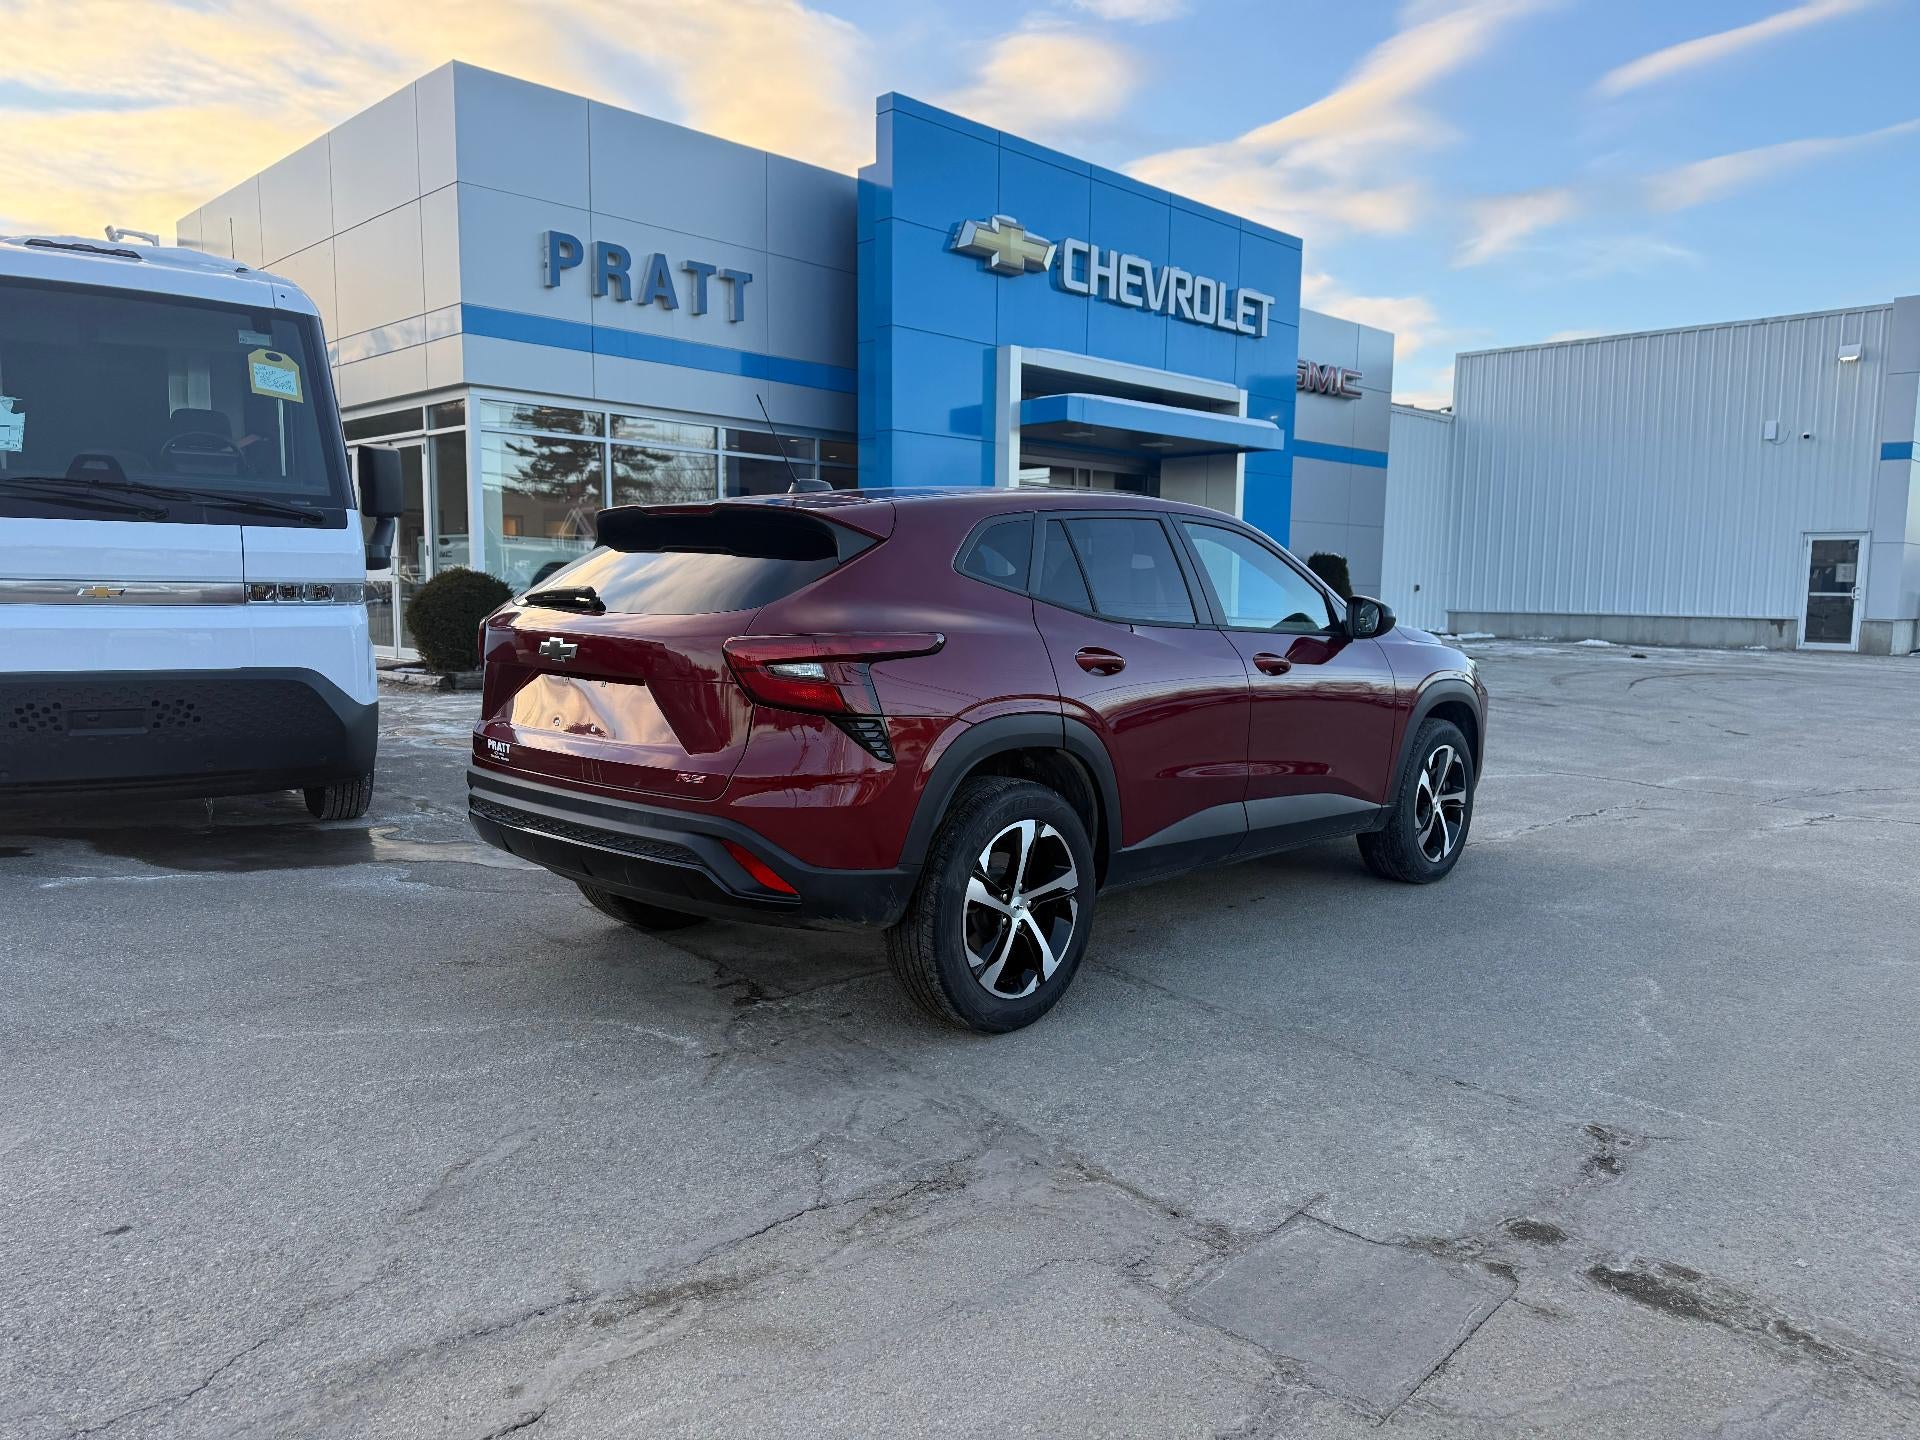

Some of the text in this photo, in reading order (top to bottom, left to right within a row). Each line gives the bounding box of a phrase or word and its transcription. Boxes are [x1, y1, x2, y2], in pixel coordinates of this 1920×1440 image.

[544, 230, 753, 322] PRATT
[1062, 237, 1276, 337] CHEVROLET
[487, 738, 511, 754] PRATT
